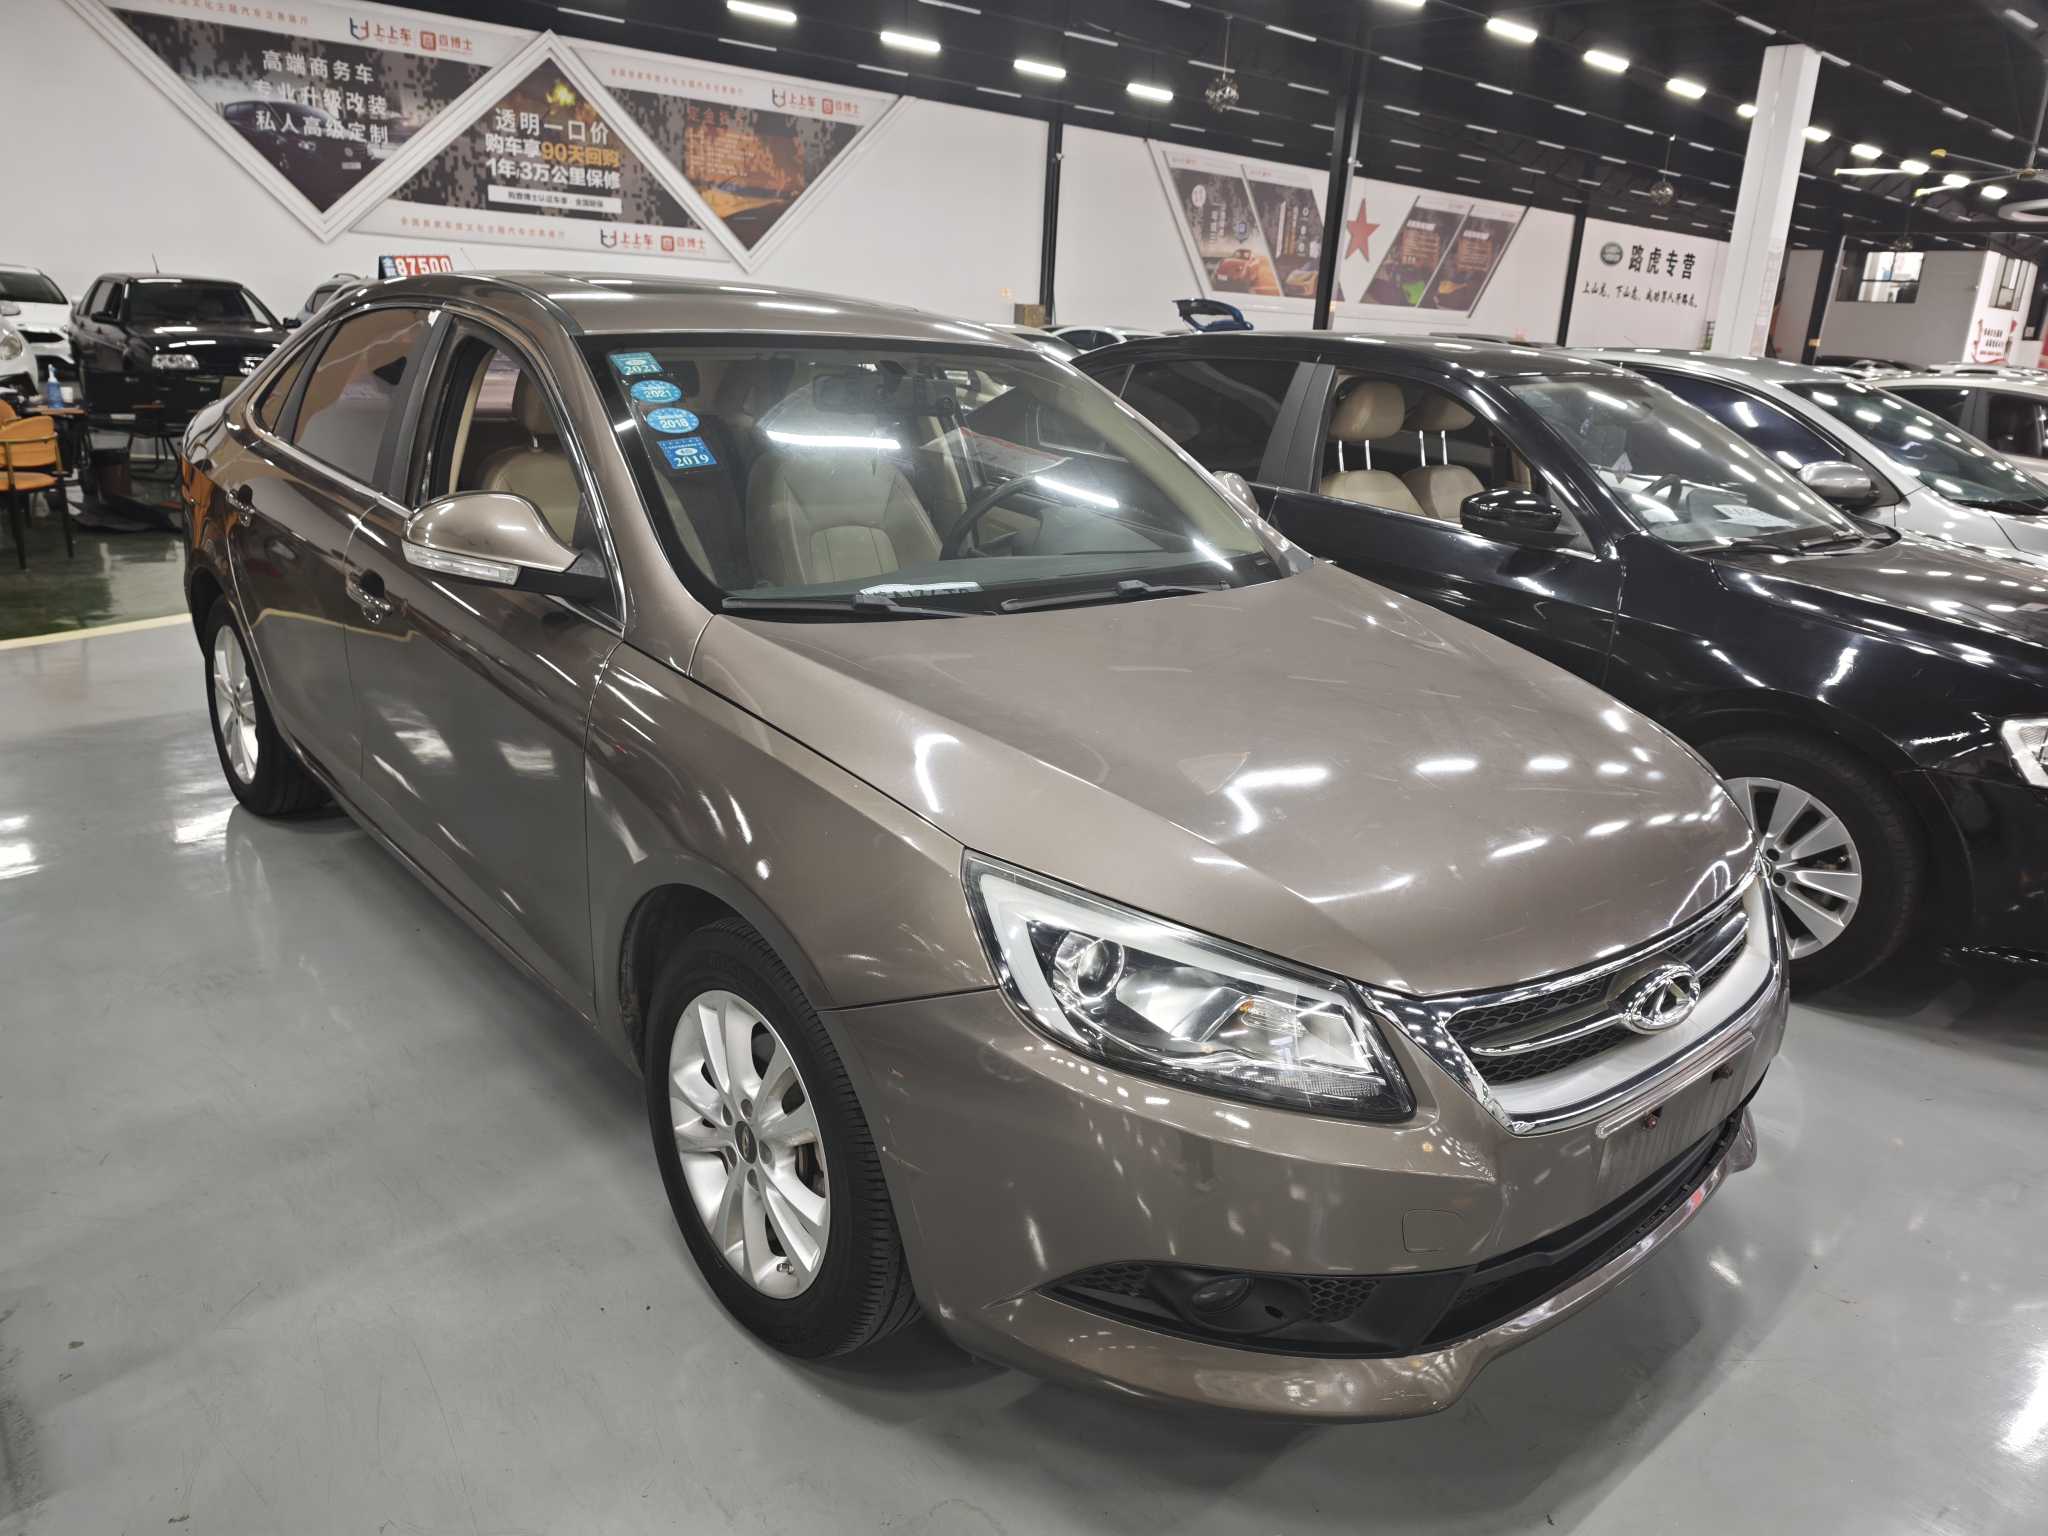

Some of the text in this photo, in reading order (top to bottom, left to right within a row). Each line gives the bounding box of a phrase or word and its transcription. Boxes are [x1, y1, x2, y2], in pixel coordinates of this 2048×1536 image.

[374, 24, 412, 42] 上上车
[262, 49, 374, 84] 高端商务车
[251, 79, 387, 119] 专业升级改装
[790, 93, 817, 107] 上上车
[255, 109, 389, 145] 私人高级定制
[495, 107, 609, 146] 透明一口价
[485, 132, 620, 168] 购车享90天回购
[620, 231, 653, 246] 上上车
[1628, 244, 1696, 280] 路虎专营
[674, 454, 710, 468] 2019
